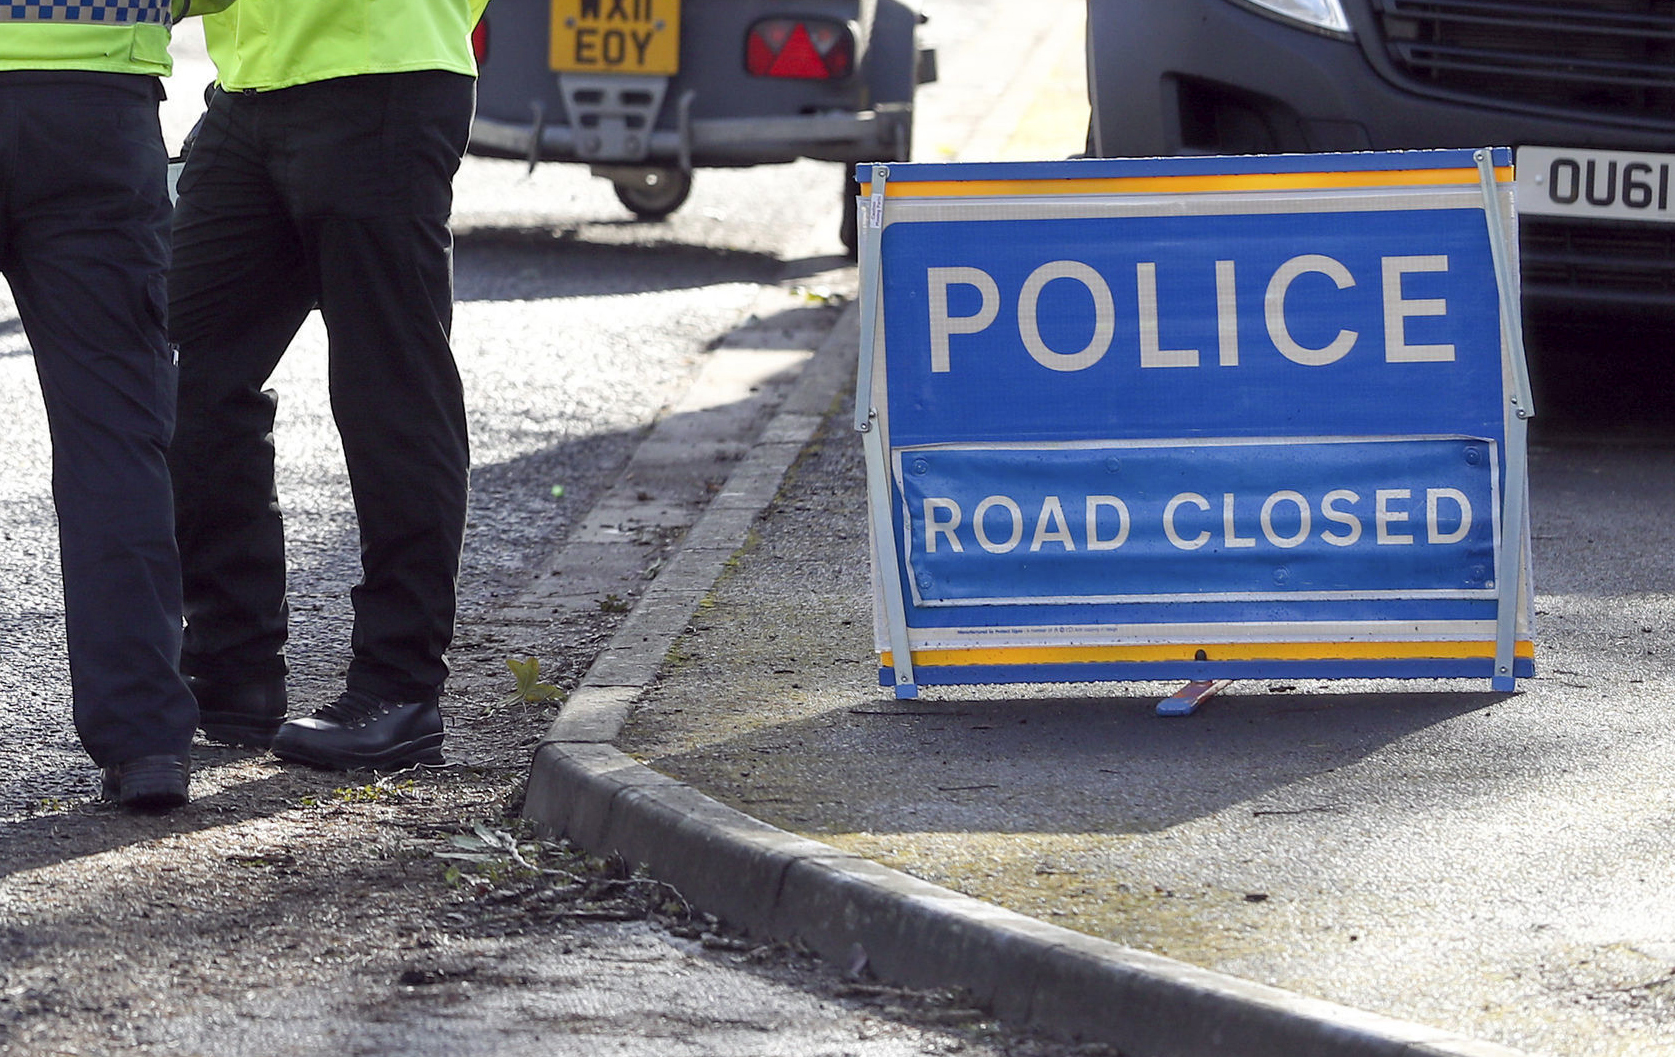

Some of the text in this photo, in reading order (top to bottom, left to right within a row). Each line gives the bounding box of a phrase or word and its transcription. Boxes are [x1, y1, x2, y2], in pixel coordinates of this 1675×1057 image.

[574, 29, 655, 66] EOY
[1548, 157, 1669, 211] OU61
[927, 253, 1456, 373] POLICE
[923, 487, 1473, 554] ROAD CLOSED
